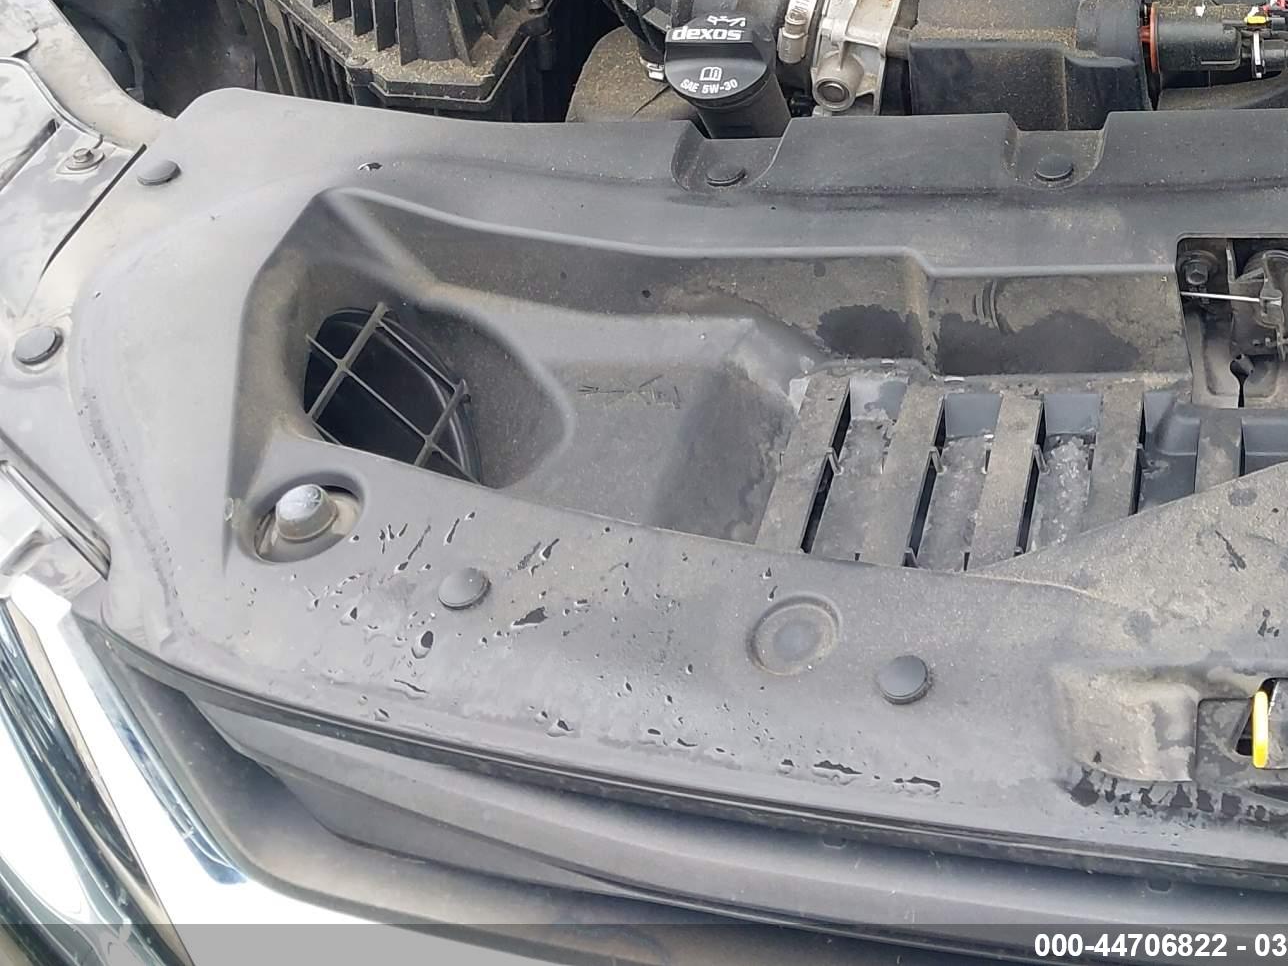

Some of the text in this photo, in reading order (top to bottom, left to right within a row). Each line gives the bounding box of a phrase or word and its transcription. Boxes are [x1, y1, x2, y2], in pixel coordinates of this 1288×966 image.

[671, 26, 742, 40] dexos
[680, 79, 738, 94] SAE 5W-30
